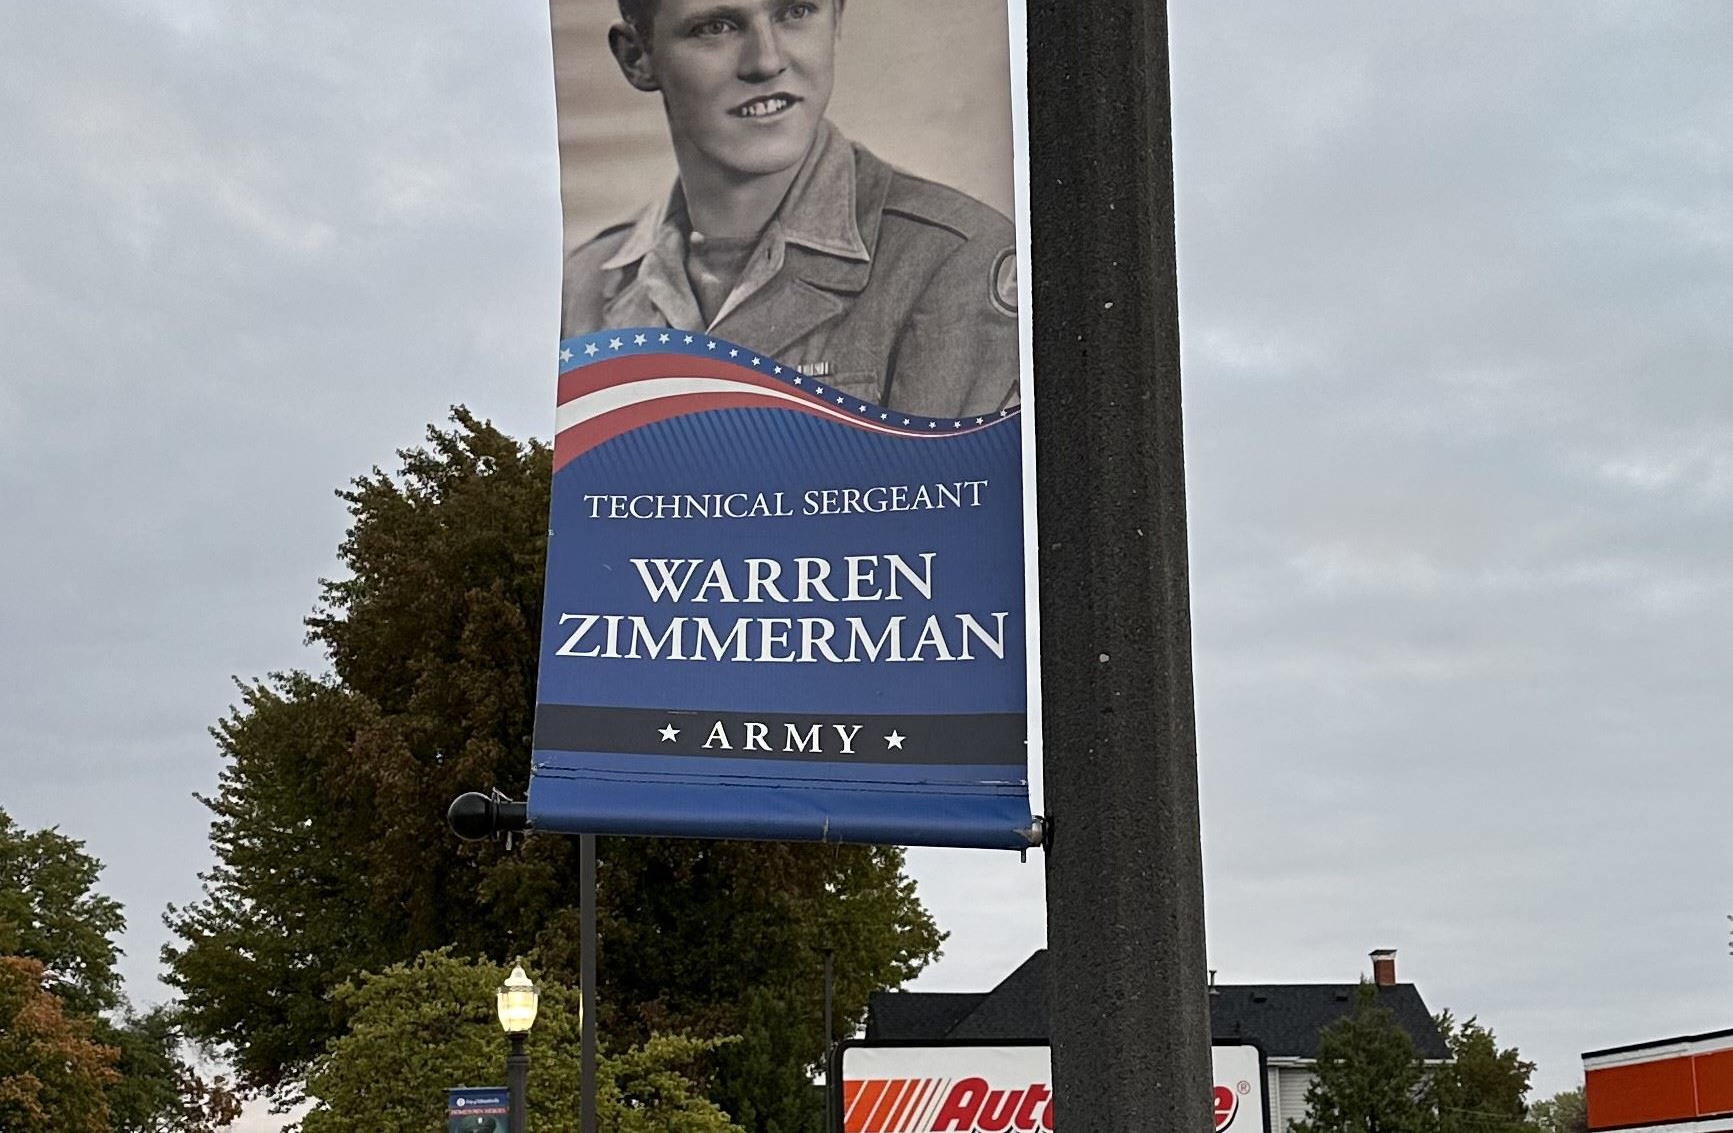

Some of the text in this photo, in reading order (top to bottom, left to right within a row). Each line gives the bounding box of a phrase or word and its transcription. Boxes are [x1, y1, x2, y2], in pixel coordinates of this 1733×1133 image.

[583, 480, 988, 519] TECHNICAL SERGEANT
[629, 552, 937, 603] WARREN
[555, 611, 1009, 663] ZIMMERMAN
[701, 720, 863, 754] ARMY
